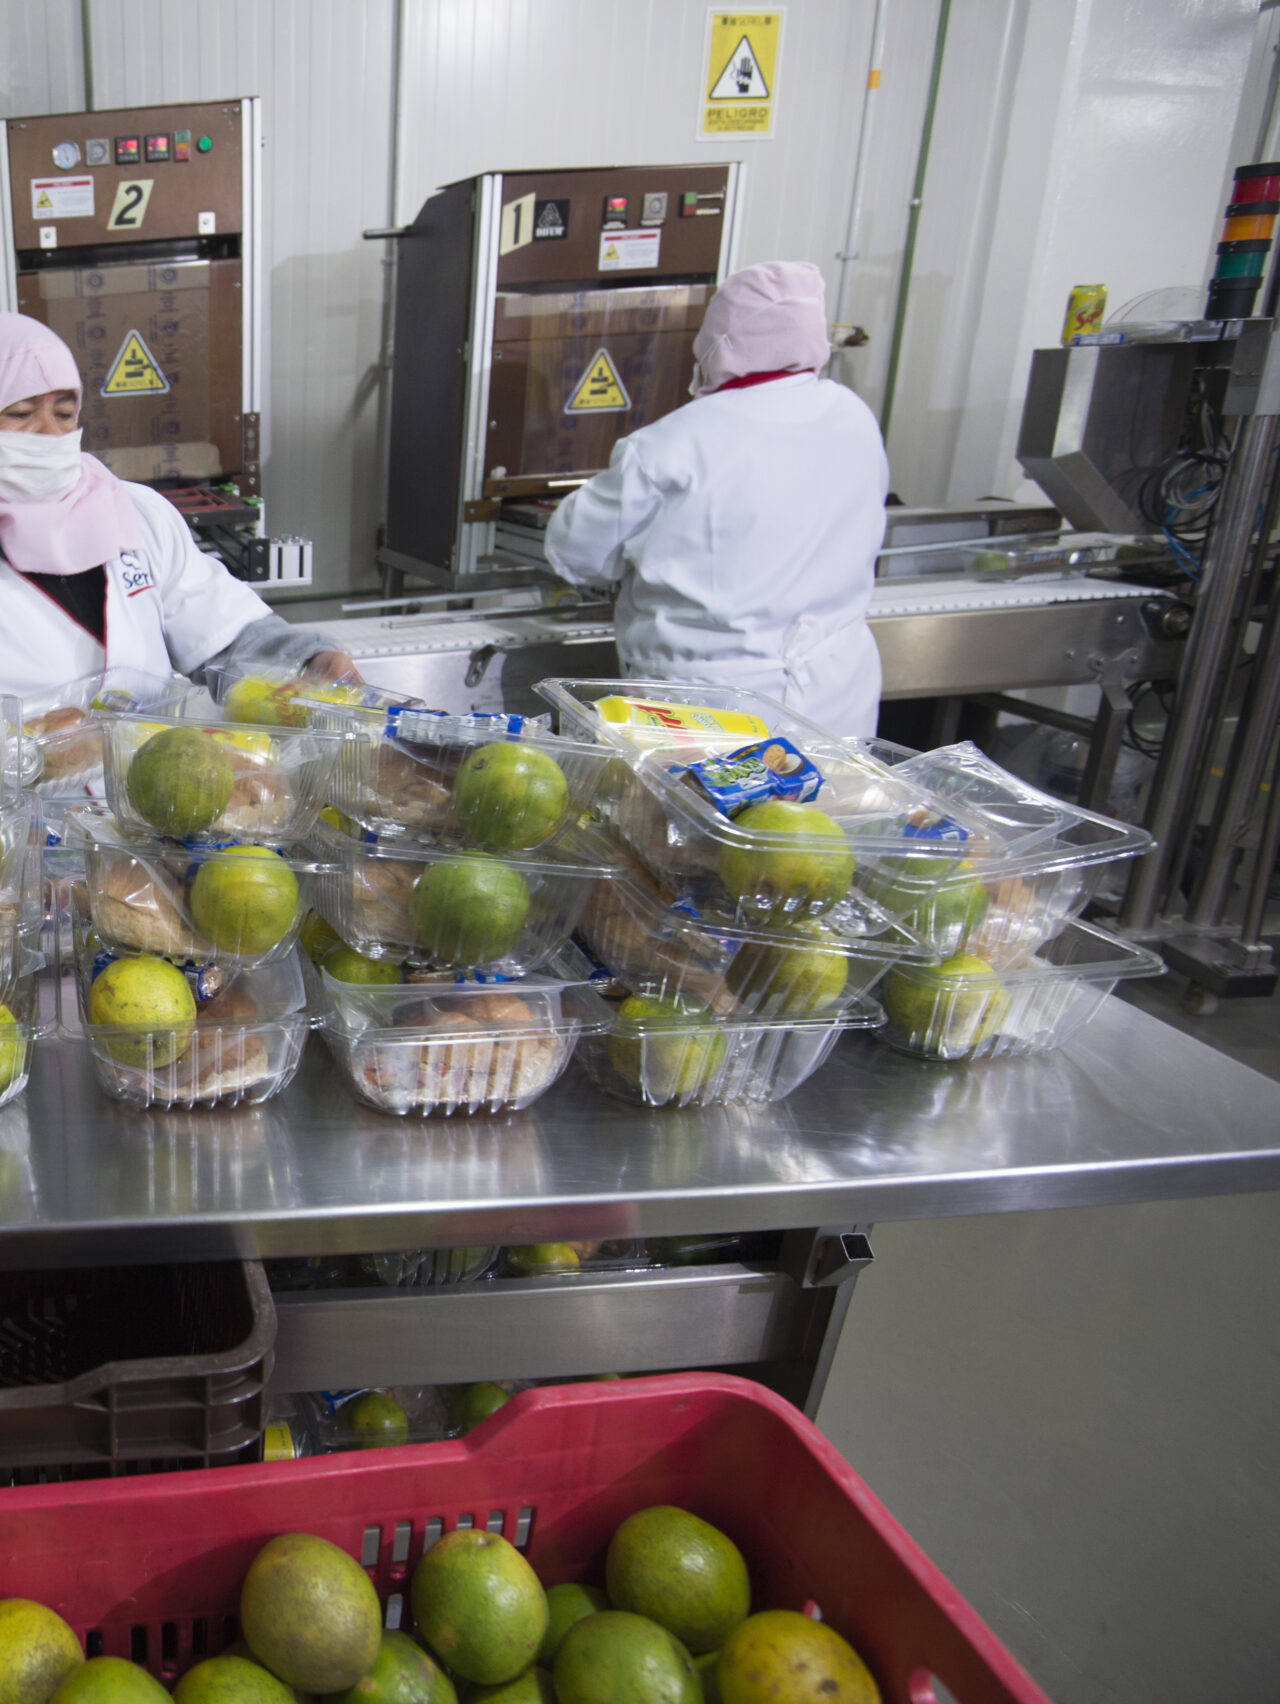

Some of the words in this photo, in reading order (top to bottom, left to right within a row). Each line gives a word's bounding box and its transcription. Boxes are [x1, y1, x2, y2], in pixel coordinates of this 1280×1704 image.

[707, 107, 768, 119] PELIGRO
[114, 184, 144, 226] 2
[513, 202, 522, 246] 1
